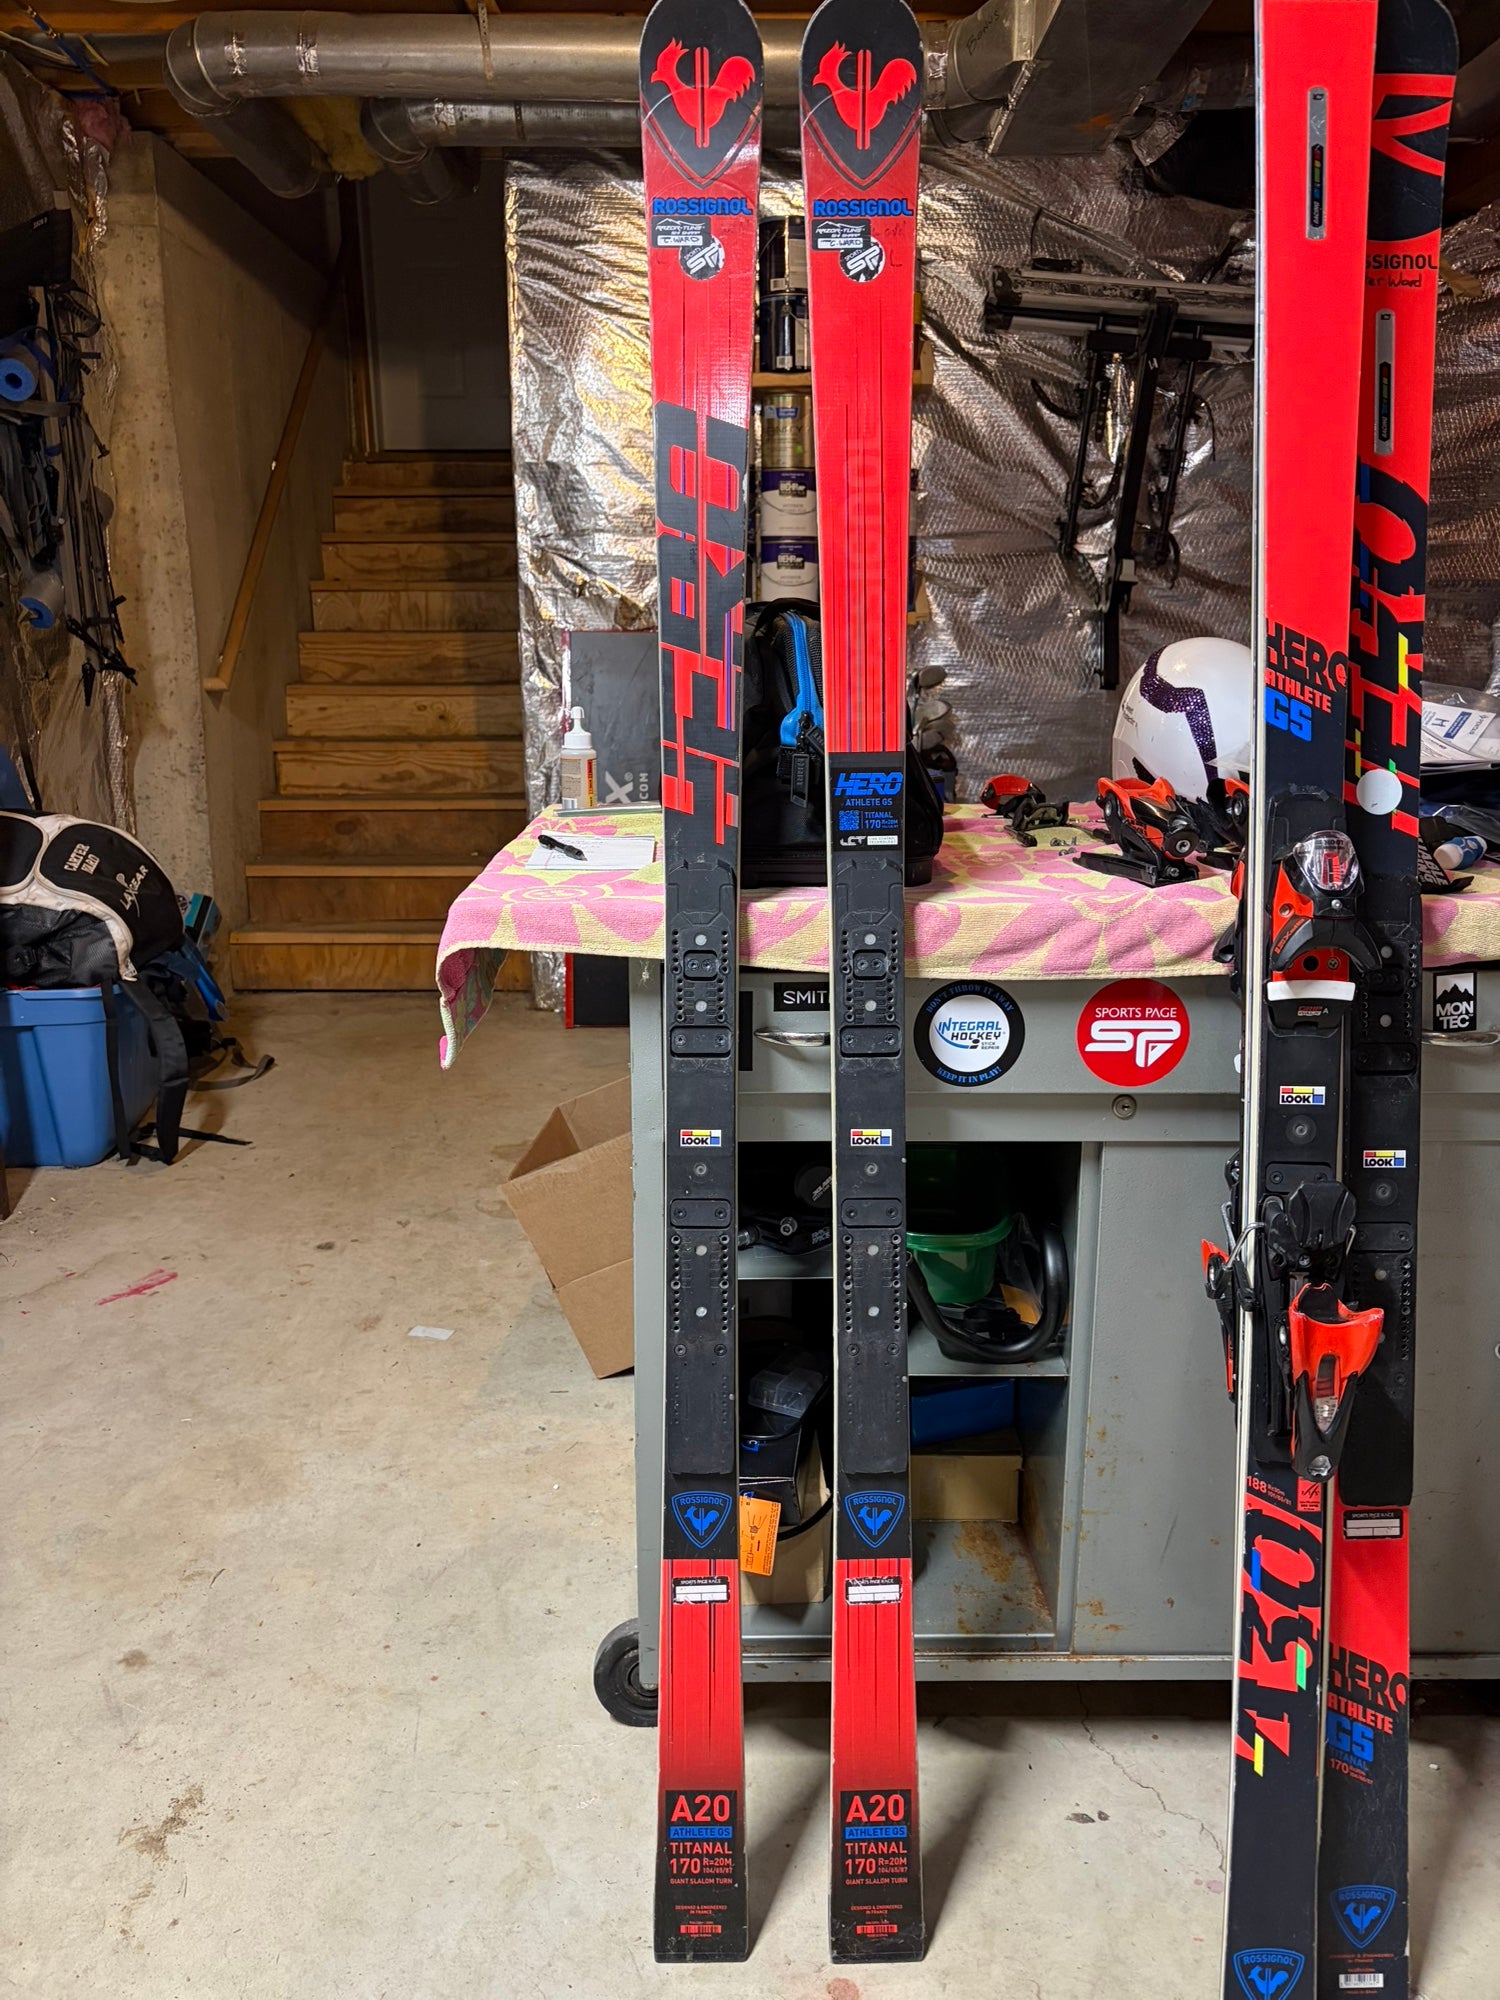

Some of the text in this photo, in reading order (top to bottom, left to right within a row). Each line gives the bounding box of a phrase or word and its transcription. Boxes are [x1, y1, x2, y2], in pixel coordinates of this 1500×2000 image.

[653, 197, 753, 215] ROSSIGNOL
[813, 199, 914, 217] ROSSIGNOL
[1366, 254, 1438, 270] SSIGNOL
[1388, 271, 1422, 288] Ward
[1266, 617, 1348, 693] HERO
[1265, 667, 1332, 714] ATHLETE
[1264, 686, 1312, 742] GS
[834, 772, 904, 796] HERO
[845, 798, 893, 806] ATHLETE GS
[864, 811, 893, 819] TITANAL
[864, 820, 881, 829] 170
[783, 990, 829, 1005] SMIT
[993, 990, 1015, 1012] AWAY
[1095, 1007, 1177, 1018] SPORTS PAGE
[1436, 1000, 1474, 1017] MON
[938, 1017, 1002, 1035] INTEGRAL
[1439, 1015, 1471, 1030] TEC
[951, 1031, 1001, 1041] HOCKEY
[936, 1066, 957, 1081] KEEP
[958, 1075, 967, 1083] IT
[968, 1075, 978, 1083] IN
[1281, 1094, 1311, 1104] LOOK
[681, 1137, 709, 1145] LOOK
[852, 1137, 879, 1145] LOOK
[1364, 1158, 1393, 1167] LOOK
[1247, 1475, 1267, 1494] 188
[680, 1496, 724, 1506] ROSSIGNOL
[853, 1495, 897, 1506] ROSSIGNOL
[1328, 1643, 1409, 1713] HERO
[1327, 1692, 1393, 1735] ATHLETE
[1327, 1710, 1374, 1763] GS
[1330, 1757, 1349, 1774] 170
[671, 1794, 730, 1822] A20
[846, 1794, 905, 1823] A20
[673, 1827, 731, 1836] ATHLETE GS
[848, 1827, 905, 1837] ATHLETE GS
[669, 1842, 732, 1854] TITANAL
[845, 1841, 907, 1855] TITANAL
[670, 1857, 732, 1874] 170 R=20M
[845, 1857, 907, 1875] 170 R=20M
[1243, 1953, 1295, 1967] ROSSIGNOL
